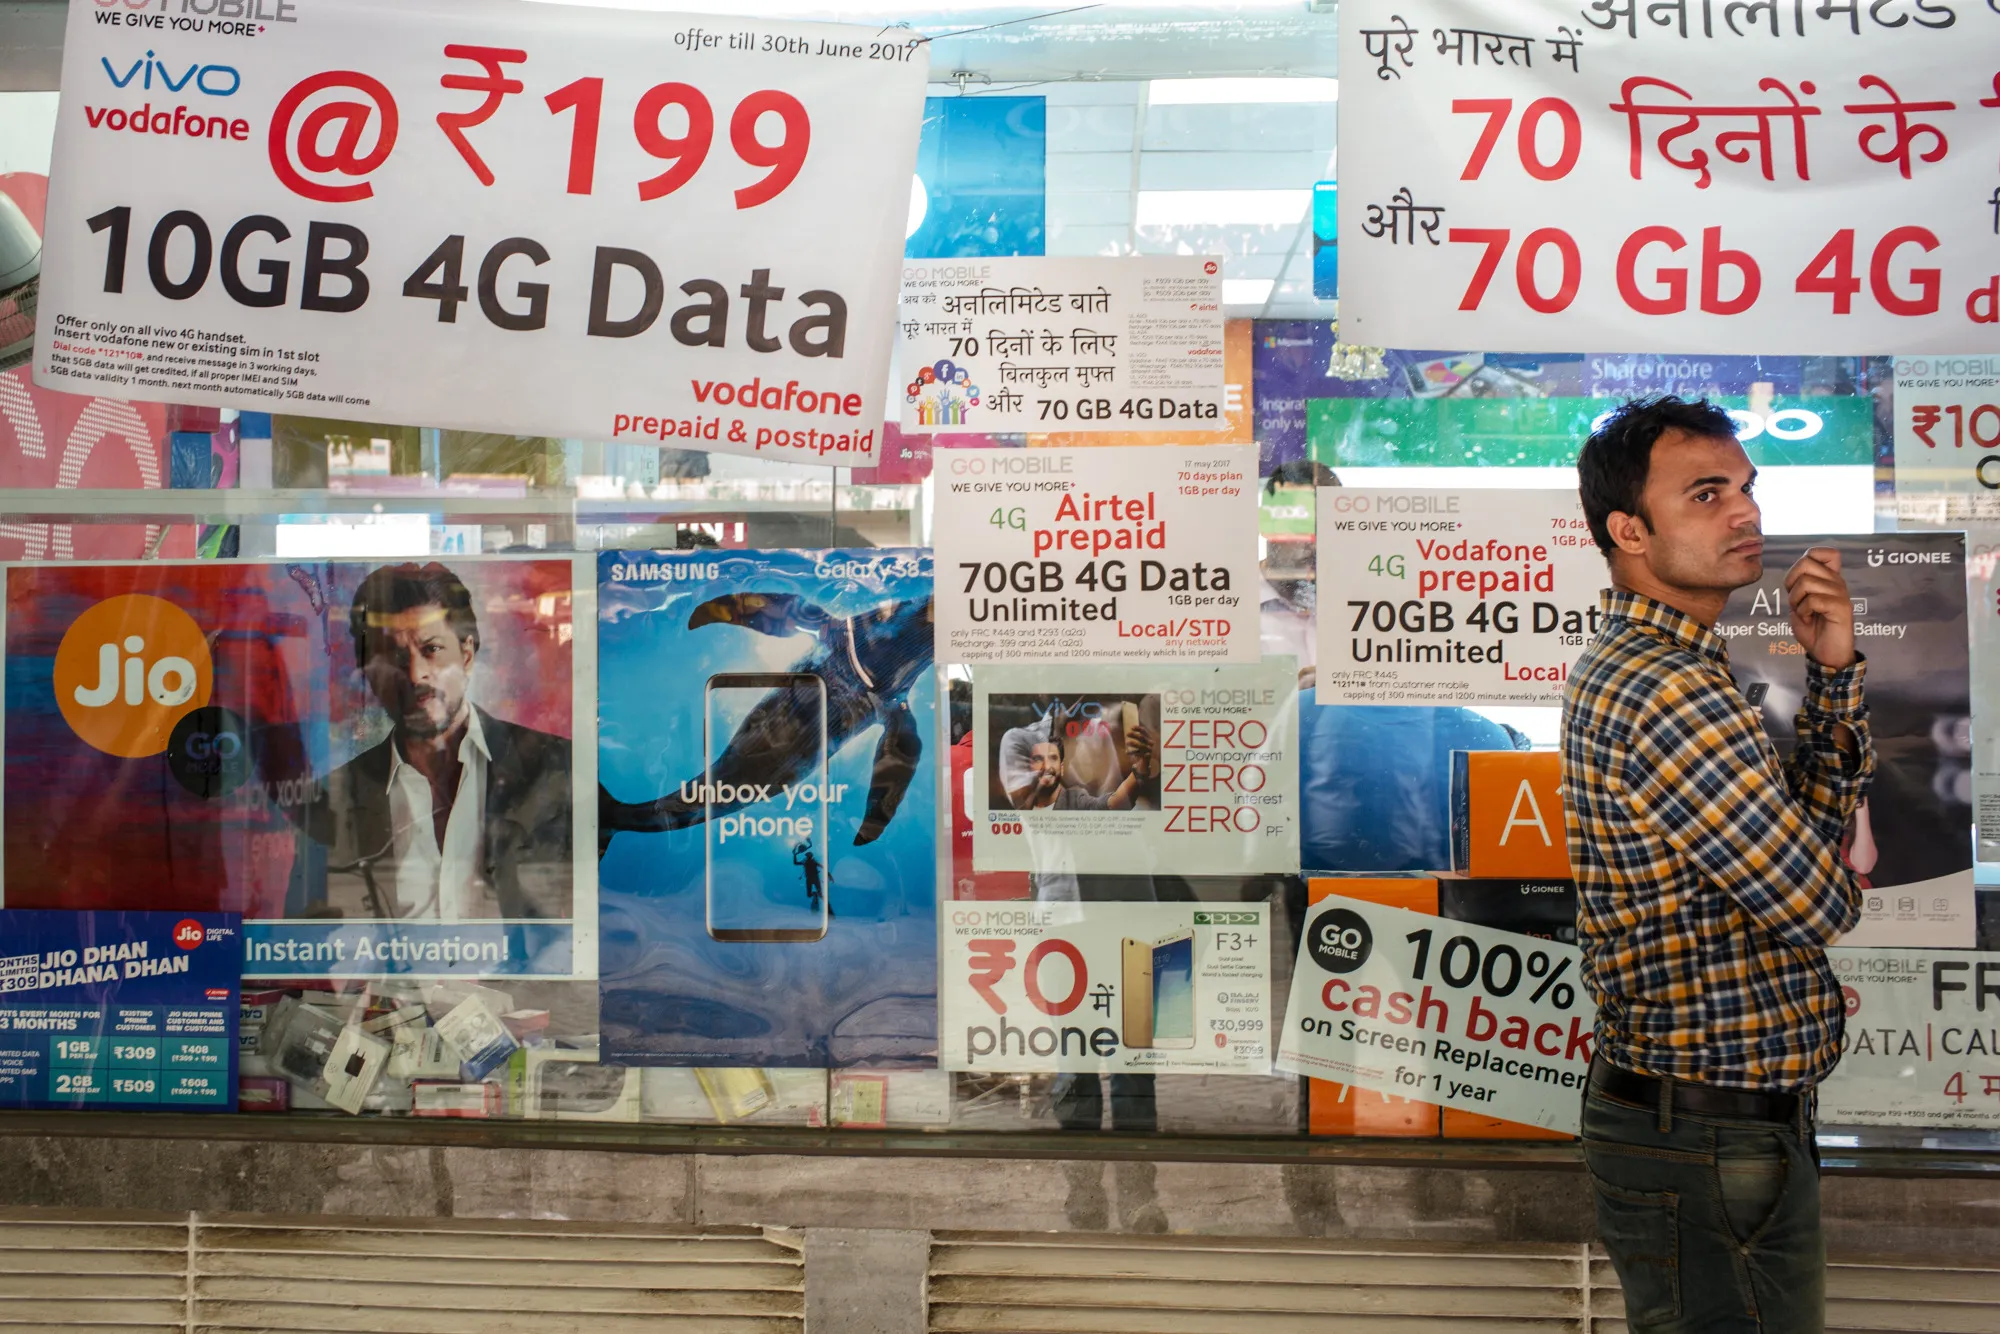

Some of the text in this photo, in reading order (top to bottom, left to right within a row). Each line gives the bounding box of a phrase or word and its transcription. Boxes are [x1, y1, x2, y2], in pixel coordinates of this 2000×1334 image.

[95, 11, 121, 26] WE
[126, 13, 164, 29] GIVE
[169, 16, 204, 32] YOU
[674, 28, 915, 62] offer till 30th June 2017
[1433, 27, 1535, 69] भारत
[1546, 27, 1584, 73] में
[101, 49, 240, 97] vivo
[85, 104, 250, 141] vodafone
[268, 70, 399, 203] @
[1452, 96, 1582, 182] 70
[1609, 76, 1822, 189] दिनों
[1844, 75, 1957, 179] के
[1361, 187, 1445, 245] और
[86, 205, 848, 359] 10GB 4G Data
[1449, 227, 1582, 313] 70
[1616, 225, 1762, 316] Gb
[1796, 225, 1943, 316] 4G
[942, 287, 1064, 315] अनलिमिटेड
[1068, 286, 1112, 314] बाते
[56, 314, 247, 344] Offer only on all vivo 4G handset.
[949, 337, 980, 357] 70
[985, 329, 1035, 358] दिनों
[1040, 329, 1064, 356] के
[1072, 327, 1118, 358] लिए
[54, 325, 320, 363] Insert vodafone new or existing sim in 1st slot
[691, 376, 862, 416] vodafone
[986, 386, 1024, 413] और
[1037, 398, 1219, 420] 70 GB 4G Data
[613, 412, 873, 456] prepaid & postpaid
[951, 456, 1074, 475] GO MOBILE
[1178, 471, 1243, 483] 70 days plan
[951, 482, 971, 492] WE
[974, 482, 1002, 492] GIVE
[1006, 482, 1031, 492] YOU
[1179, 486, 1240, 498] 1GB per day
[990, 491, 1155, 531] 4G Airtel
[1334, 496, 1460, 513] GO MOBILE
[1034, 521, 1166, 558] prepaid
[611, 562, 720, 582] SAMSUNG
[814, 560, 892, 581] Galaxy
[1368, 539, 1547, 580] 4G Vodafone
[1888, 552, 1951, 564] GIONEE
[960, 559, 1231, 593] 70GB 4G Data
[1418, 564, 1554, 599] prepaid
[969, 597, 1117, 622] Unlimited
[1168, 594, 1239, 607] 1GB per day
[1750, 588, 1782, 615] A1
[1118, 618, 1231, 638] Local/STD
[1347, 600, 1601, 634] 70GB 4G Dat
[1714, 622, 1754, 637] Super
[1854, 623, 1907, 639] Battery
[1352, 638, 1503, 664] Unlimited
[74, 634, 198, 707] Jio
[1031, 697, 1104, 719] vivo
[1201, 690, 1275, 705] MOBILE
[1163, 720, 1268, 749] ZERO
[1186, 750, 1283, 764] Downpayment
[1163, 764, 1266, 792] ZERO
[680, 780, 848, 811] Unbox your
[1234, 794, 1283, 805] interest
[719, 813, 814, 844] phone
[1163, 806, 1261, 833] ZERO
[952, 911, 1053, 926] GO MOBILE
[1196, 913, 1257, 924] oppo
[176, 927, 202, 942] Jio
[245, 934, 511, 962] Instant Activation!
[1216, 933, 1257, 951] F3+
[1320, 924, 1362, 948] GO
[40, 941, 148, 970] JIO DHAN
[1318, 944, 1358, 961] MOBILE
[1858, 958, 1927, 973] MOBILE
[39, 955, 189, 989] DHANA DHAN
[1406, 928, 1575, 1010] 100%
[1089, 984, 1115, 1018] में
[13, 1018, 77, 1030] MONTHS
[1321, 978, 1594, 1064] cash back
[114, 1046, 156, 1059] ₹309
[967, 1017, 1119, 1064] phone
[1301, 1017, 1586, 1090] on Screen Replaceme
[113, 1079, 155, 1092] ₹509
[1395, 1066, 1497, 1102] for 1 year
